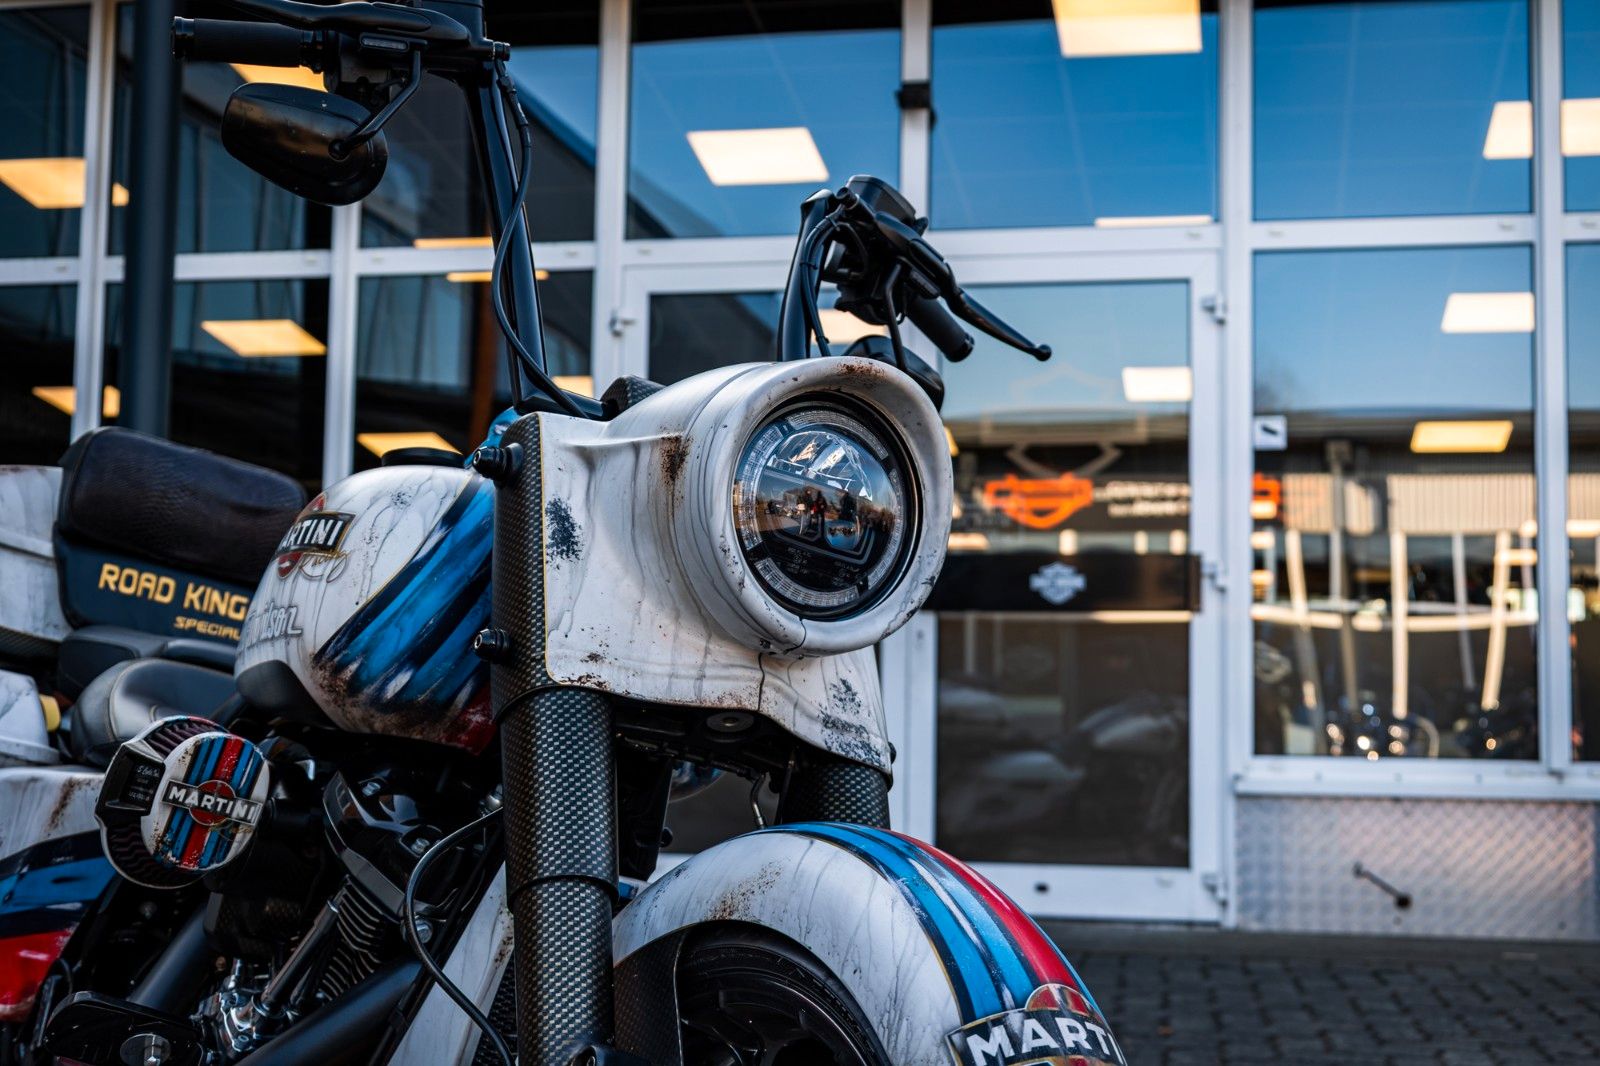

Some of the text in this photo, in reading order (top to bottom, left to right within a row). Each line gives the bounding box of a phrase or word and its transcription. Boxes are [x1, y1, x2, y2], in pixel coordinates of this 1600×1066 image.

[280, 519, 344, 547] ARTINI
[98, 562, 249, 621] ROAD KING
[174, 615, 241, 641] SPECIAL
[169, 786, 255, 821] MARTINI
